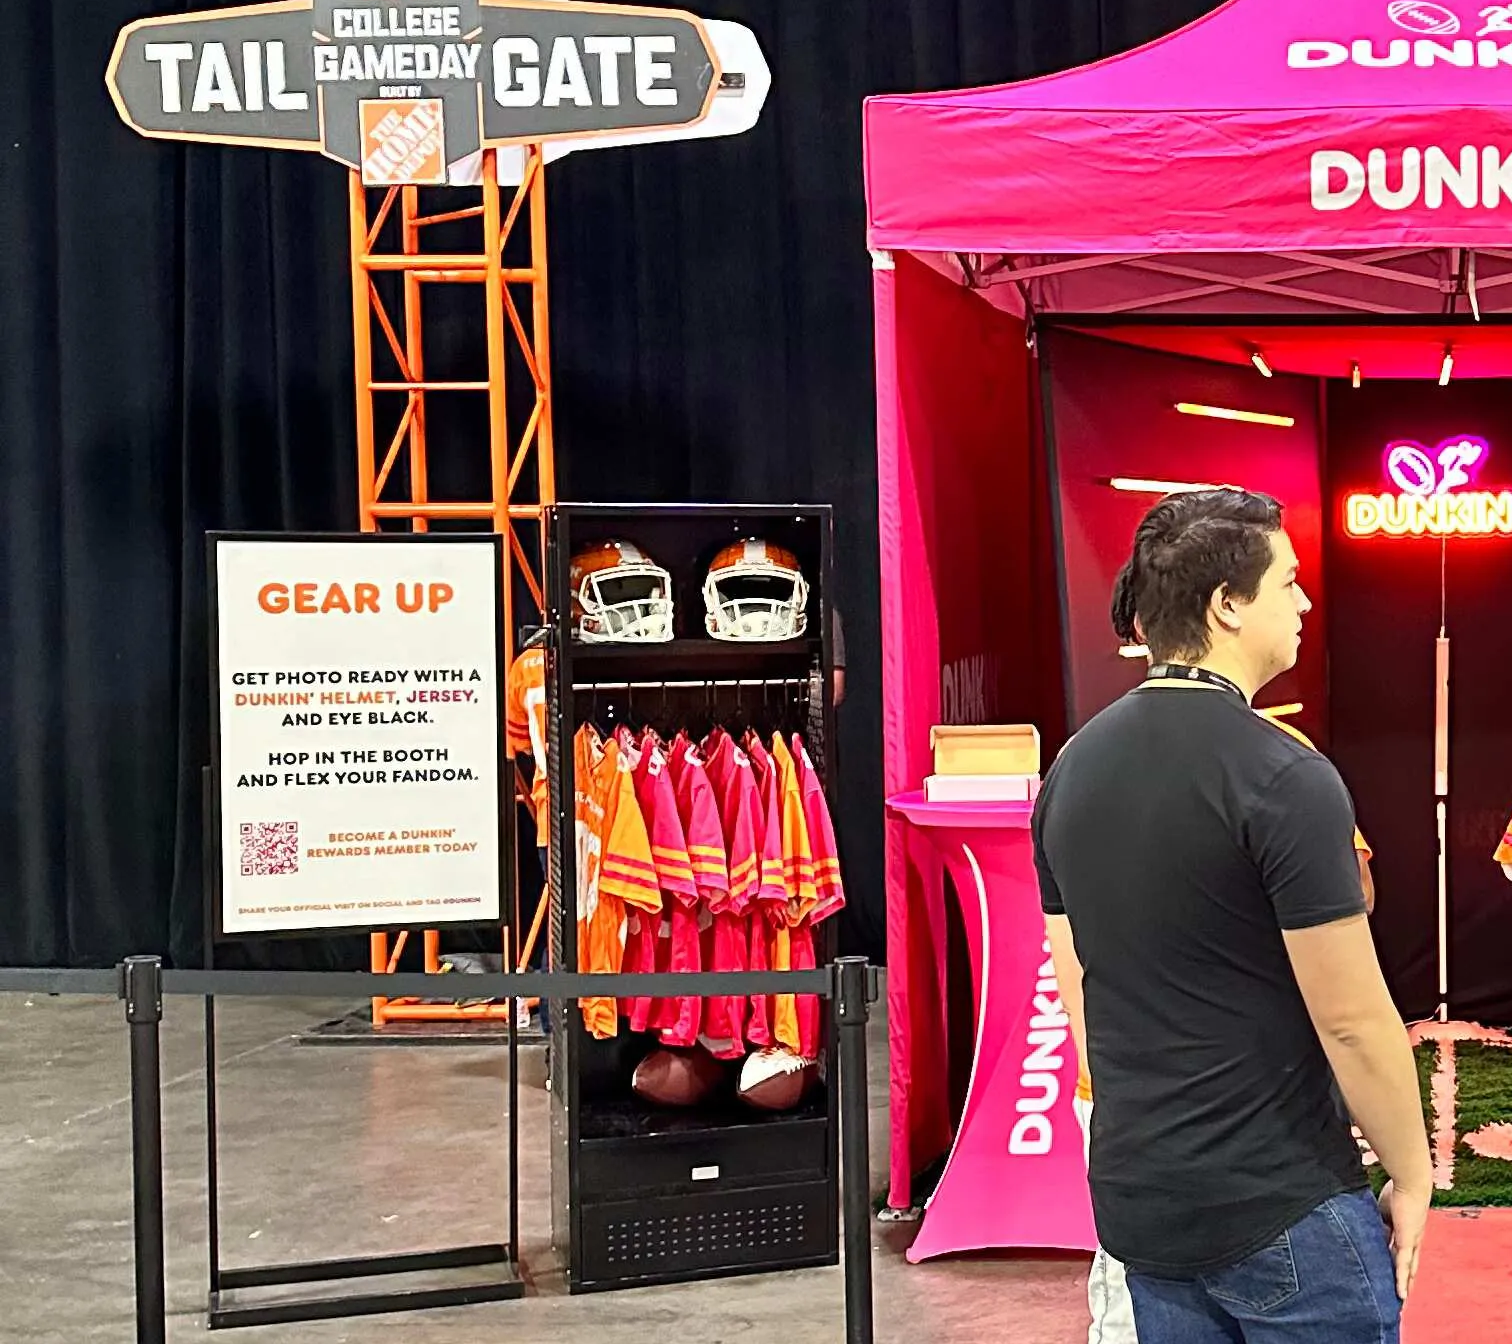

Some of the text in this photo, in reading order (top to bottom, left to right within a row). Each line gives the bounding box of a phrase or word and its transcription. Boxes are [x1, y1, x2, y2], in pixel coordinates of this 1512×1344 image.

[333, 5, 461, 38] COLLEGE
[144, 40, 309, 113] TAIL
[313, 43, 481, 82] GAMEDAY
[491, 35, 679, 108] GATE
[369, 108, 403, 140] THE
[364, 100, 440, 181] HOME
[393, 129, 441, 181] DEPOT
[257, 582, 454, 615] GEAR UP
[232, 669, 481, 686] GET PHOTO READY WITH A
[234, 690, 479, 706] DUNKIN' HELMET, JERSEY,
[281, 710, 434, 727] AND EYE BLACK.
[268, 748, 449, 766] HOP IN THE BOOTH
[237, 768, 479, 787] AND FLEX YOUR FANDOM.
[307, 842, 478, 858] REWARDS MEMBER TODAY
[328, 828, 456, 843] BECOME A DUNKIN'
